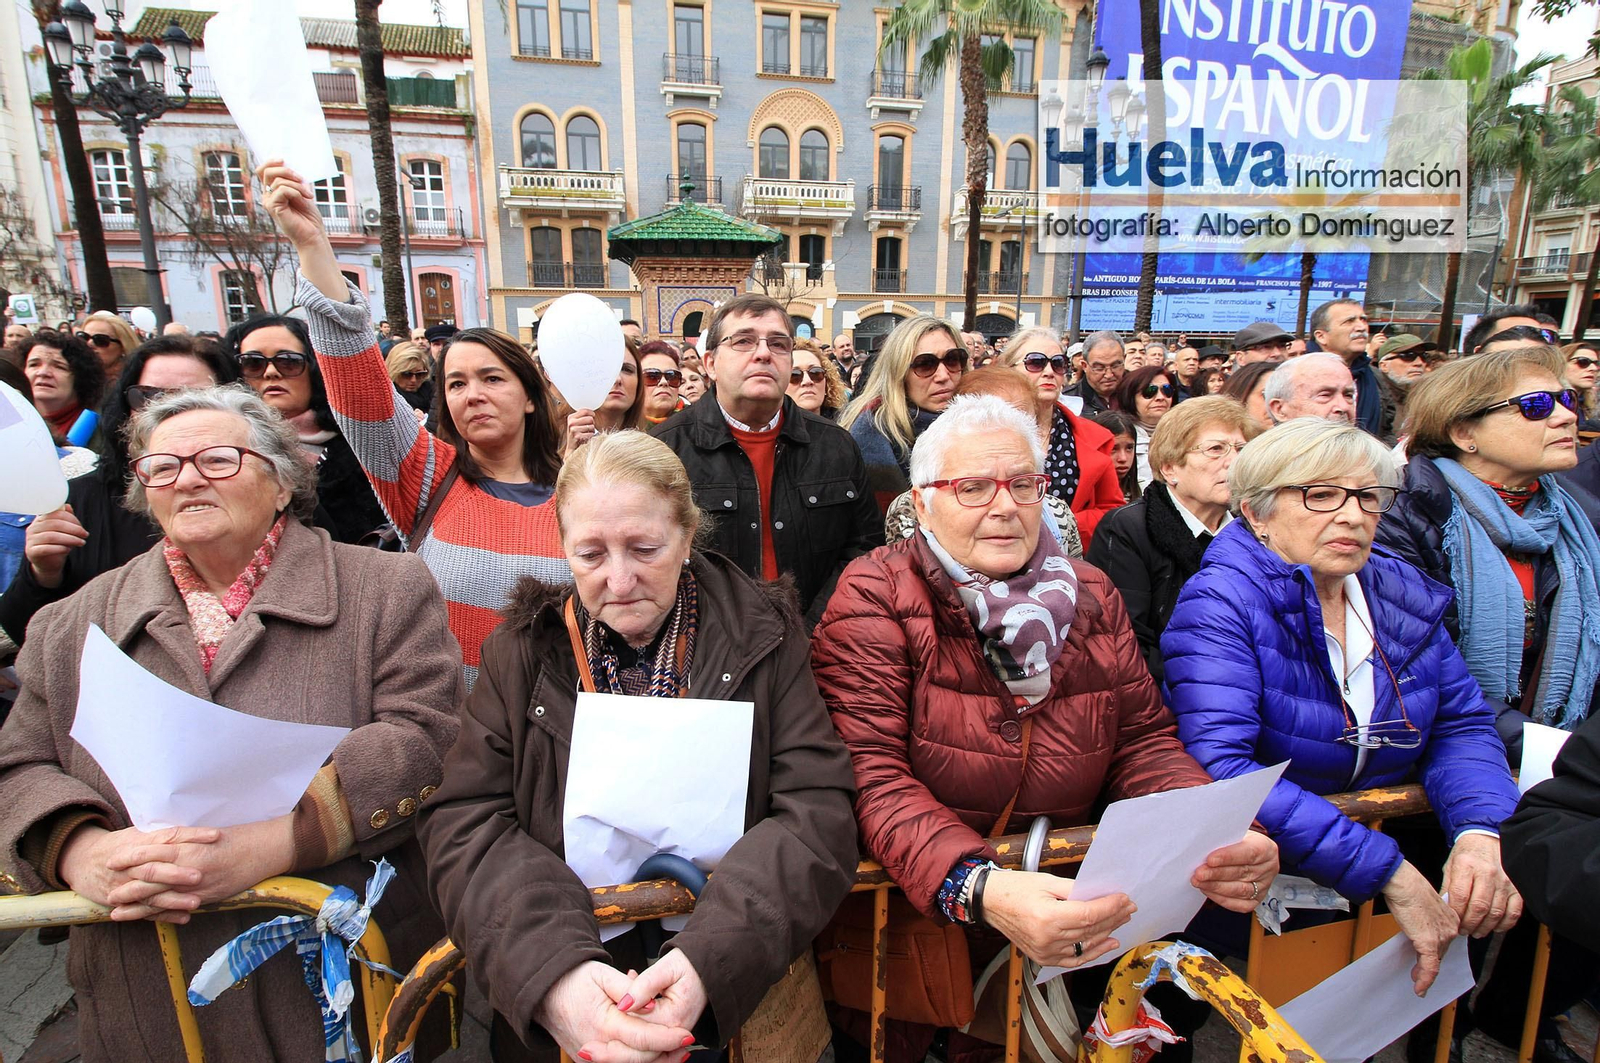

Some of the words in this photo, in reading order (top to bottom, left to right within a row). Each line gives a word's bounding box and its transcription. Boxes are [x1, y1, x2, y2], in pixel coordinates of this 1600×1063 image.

[1160, 0, 1377, 59] NSTITUTO
[1093, 274, 1127, 282] ANTIGUO
[1081, 288, 1100, 296] BRAS
